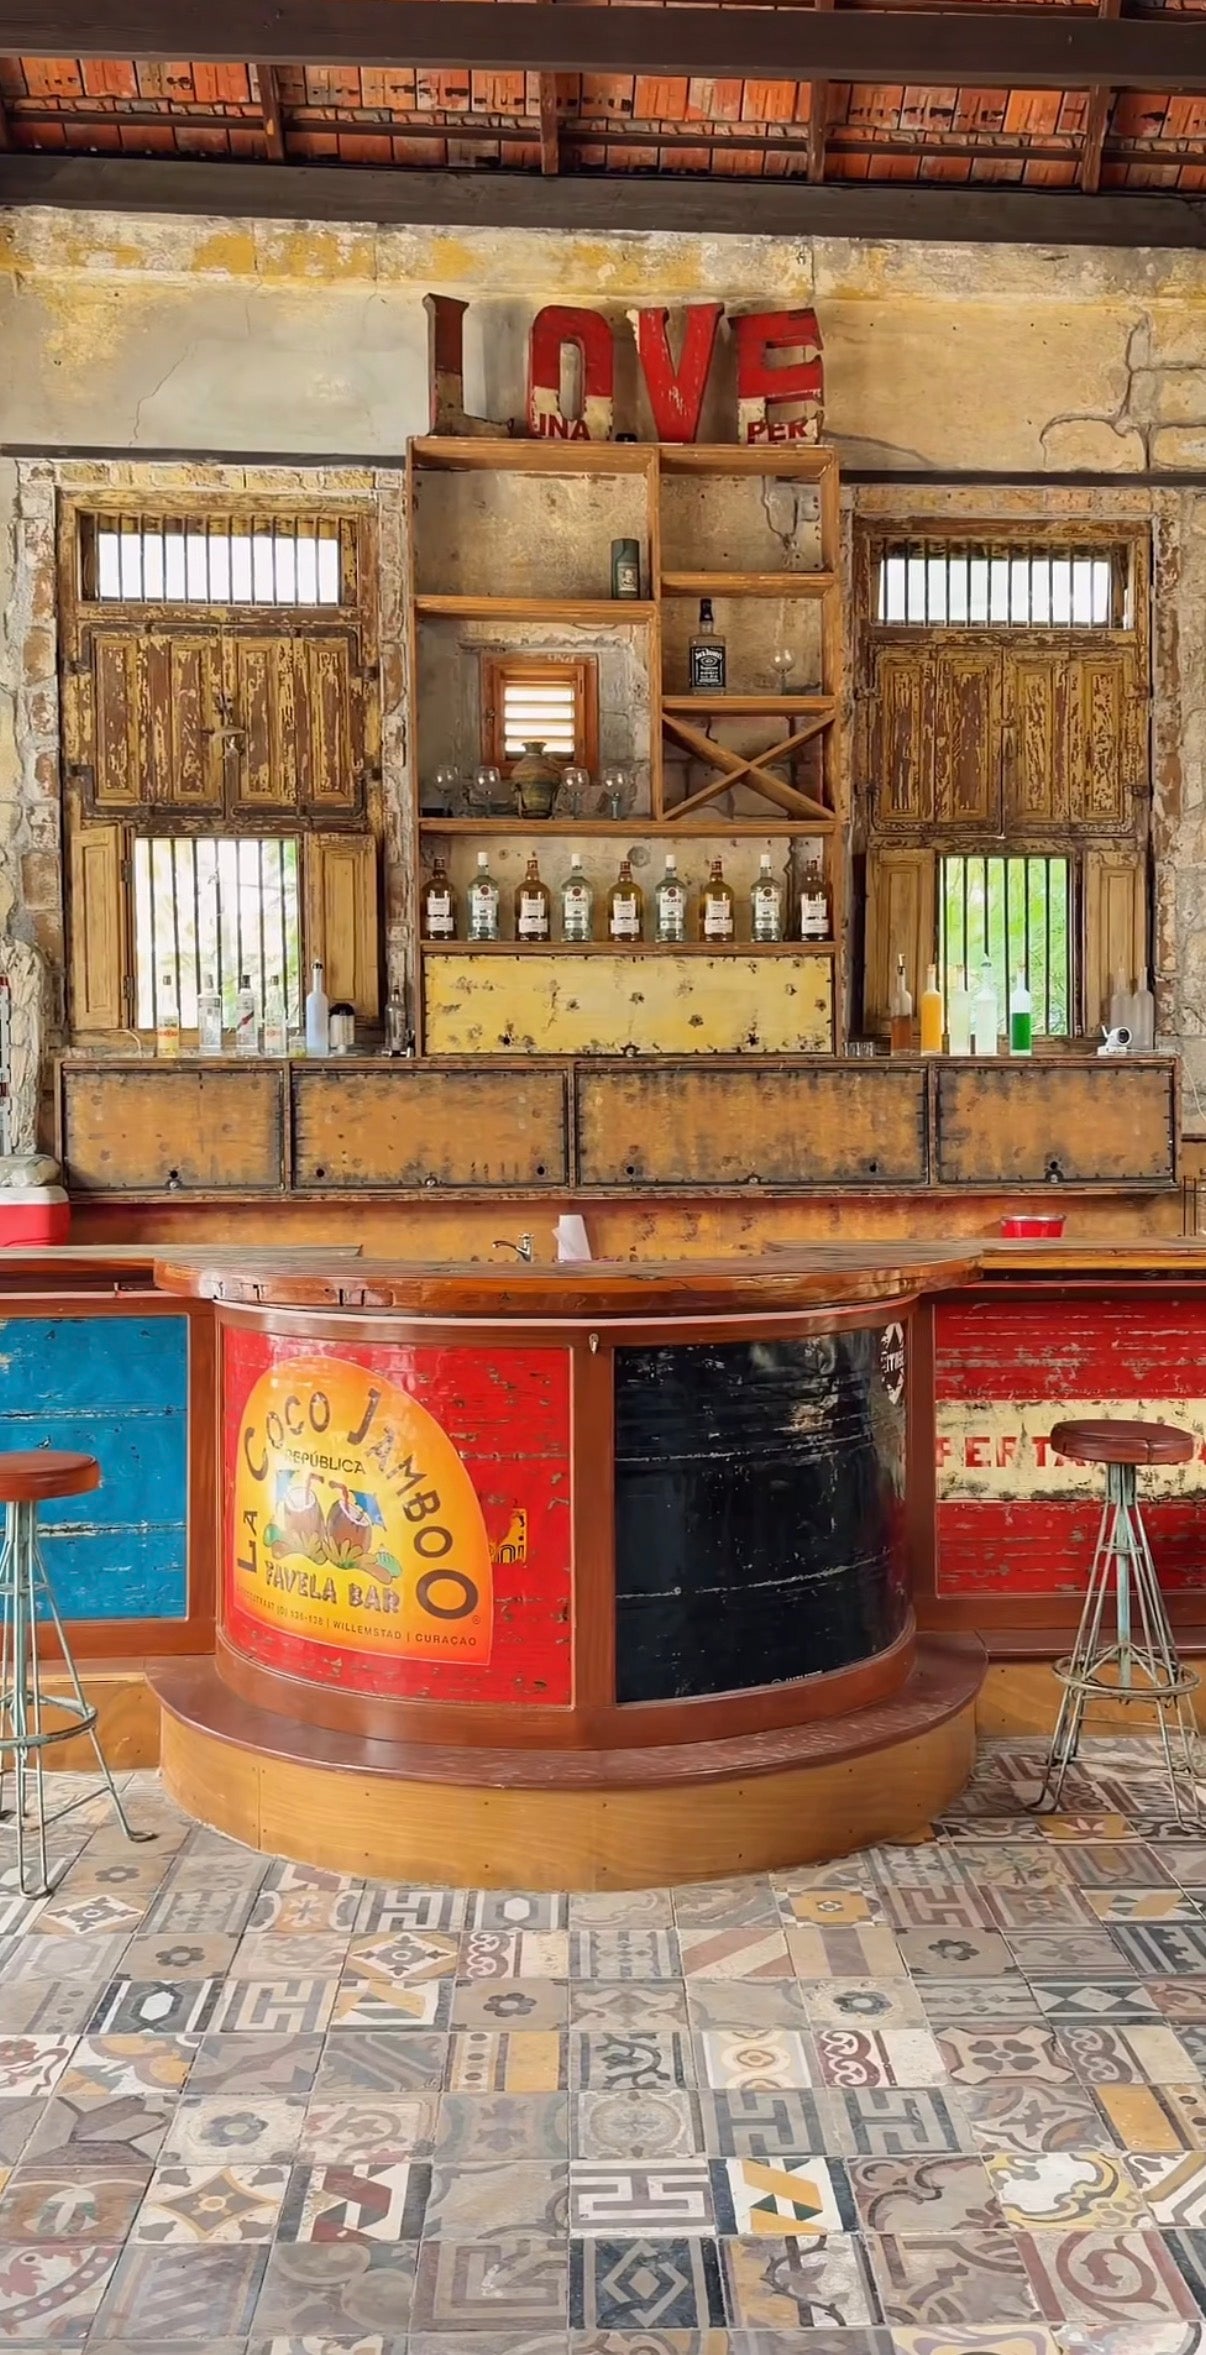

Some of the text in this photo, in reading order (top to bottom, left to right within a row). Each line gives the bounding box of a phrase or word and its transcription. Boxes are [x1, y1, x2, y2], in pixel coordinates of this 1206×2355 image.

[422, 293, 824, 445] LOVE
[237, 1387, 479, 1620] LA COCO JAMBOO
[264, 1559, 338, 1604] FAVELA
[348, 1581, 400, 1614] BAR
[333, 1619, 402, 1640] WILLEMSTAD
